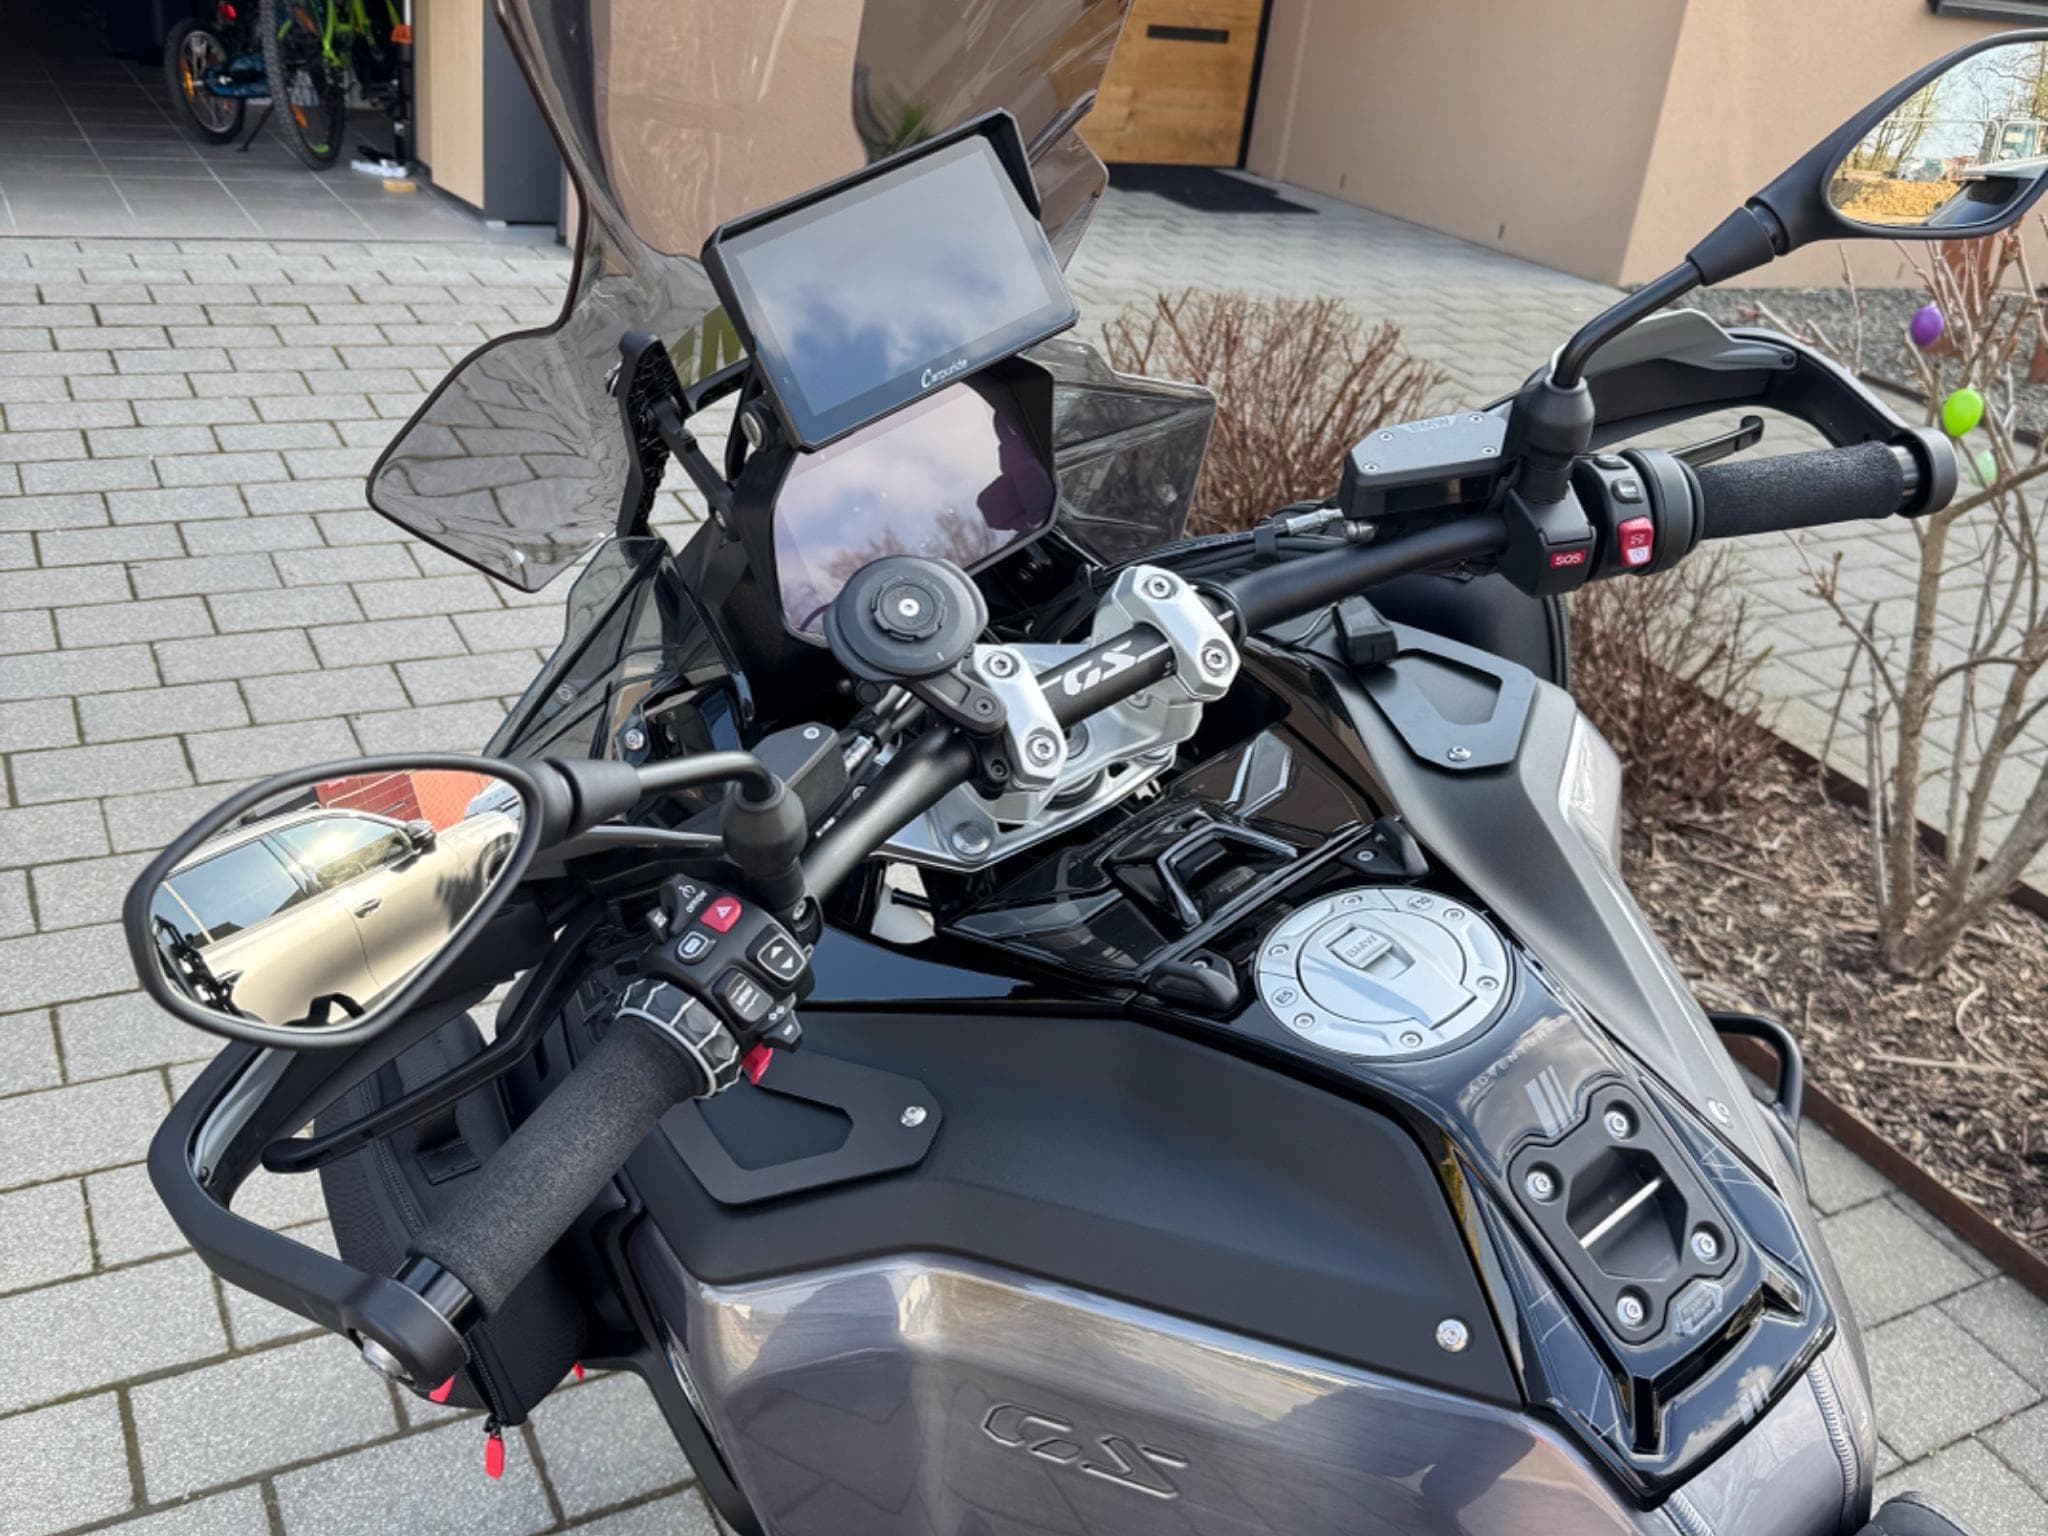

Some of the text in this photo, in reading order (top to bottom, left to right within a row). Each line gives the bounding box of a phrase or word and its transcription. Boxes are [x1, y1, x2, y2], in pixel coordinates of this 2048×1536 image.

[1554, 552, 1582, 566] SOS
[1063, 640, 1137, 696] GS
[1345, 933, 1378, 957] BMW
[981, 1403, 1190, 1499] GS
